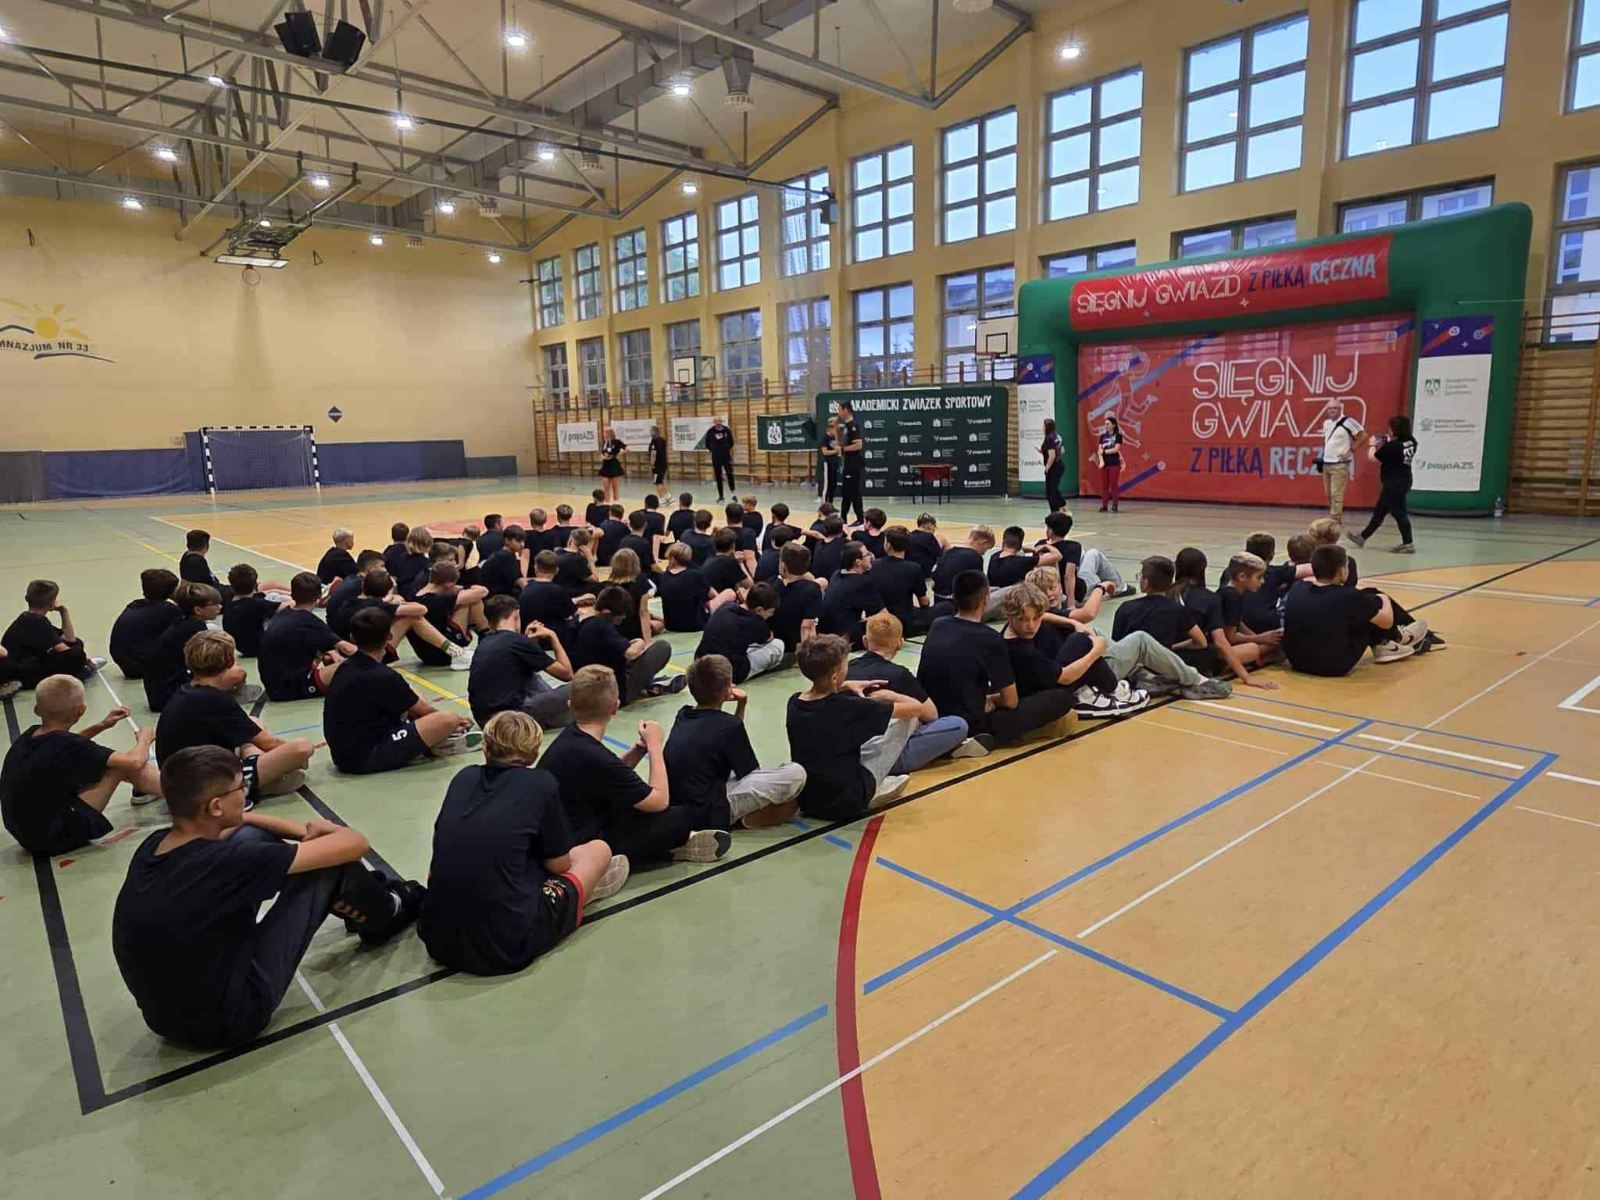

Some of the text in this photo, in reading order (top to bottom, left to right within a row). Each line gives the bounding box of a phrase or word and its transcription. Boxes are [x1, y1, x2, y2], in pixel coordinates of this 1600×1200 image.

[1077, 286, 1148, 316] SIĘGNIJ
[1156, 274, 1241, 304] GWIAZD
[1248, 272, 1260, 292] Z
[58, 342, 73, 350] NR
[76, 343, 89, 352] 33
[1192, 351, 1359, 405] SIĘGNIJ
[902, 397, 941, 410] ZWIĄZEK
[945, 395, 992, 409] SPORTOWY
[1190, 447, 1204, 473] Z
[1208, 446, 1263, 478] PIŁKĄ
[391, 729, 408, 742] 5
